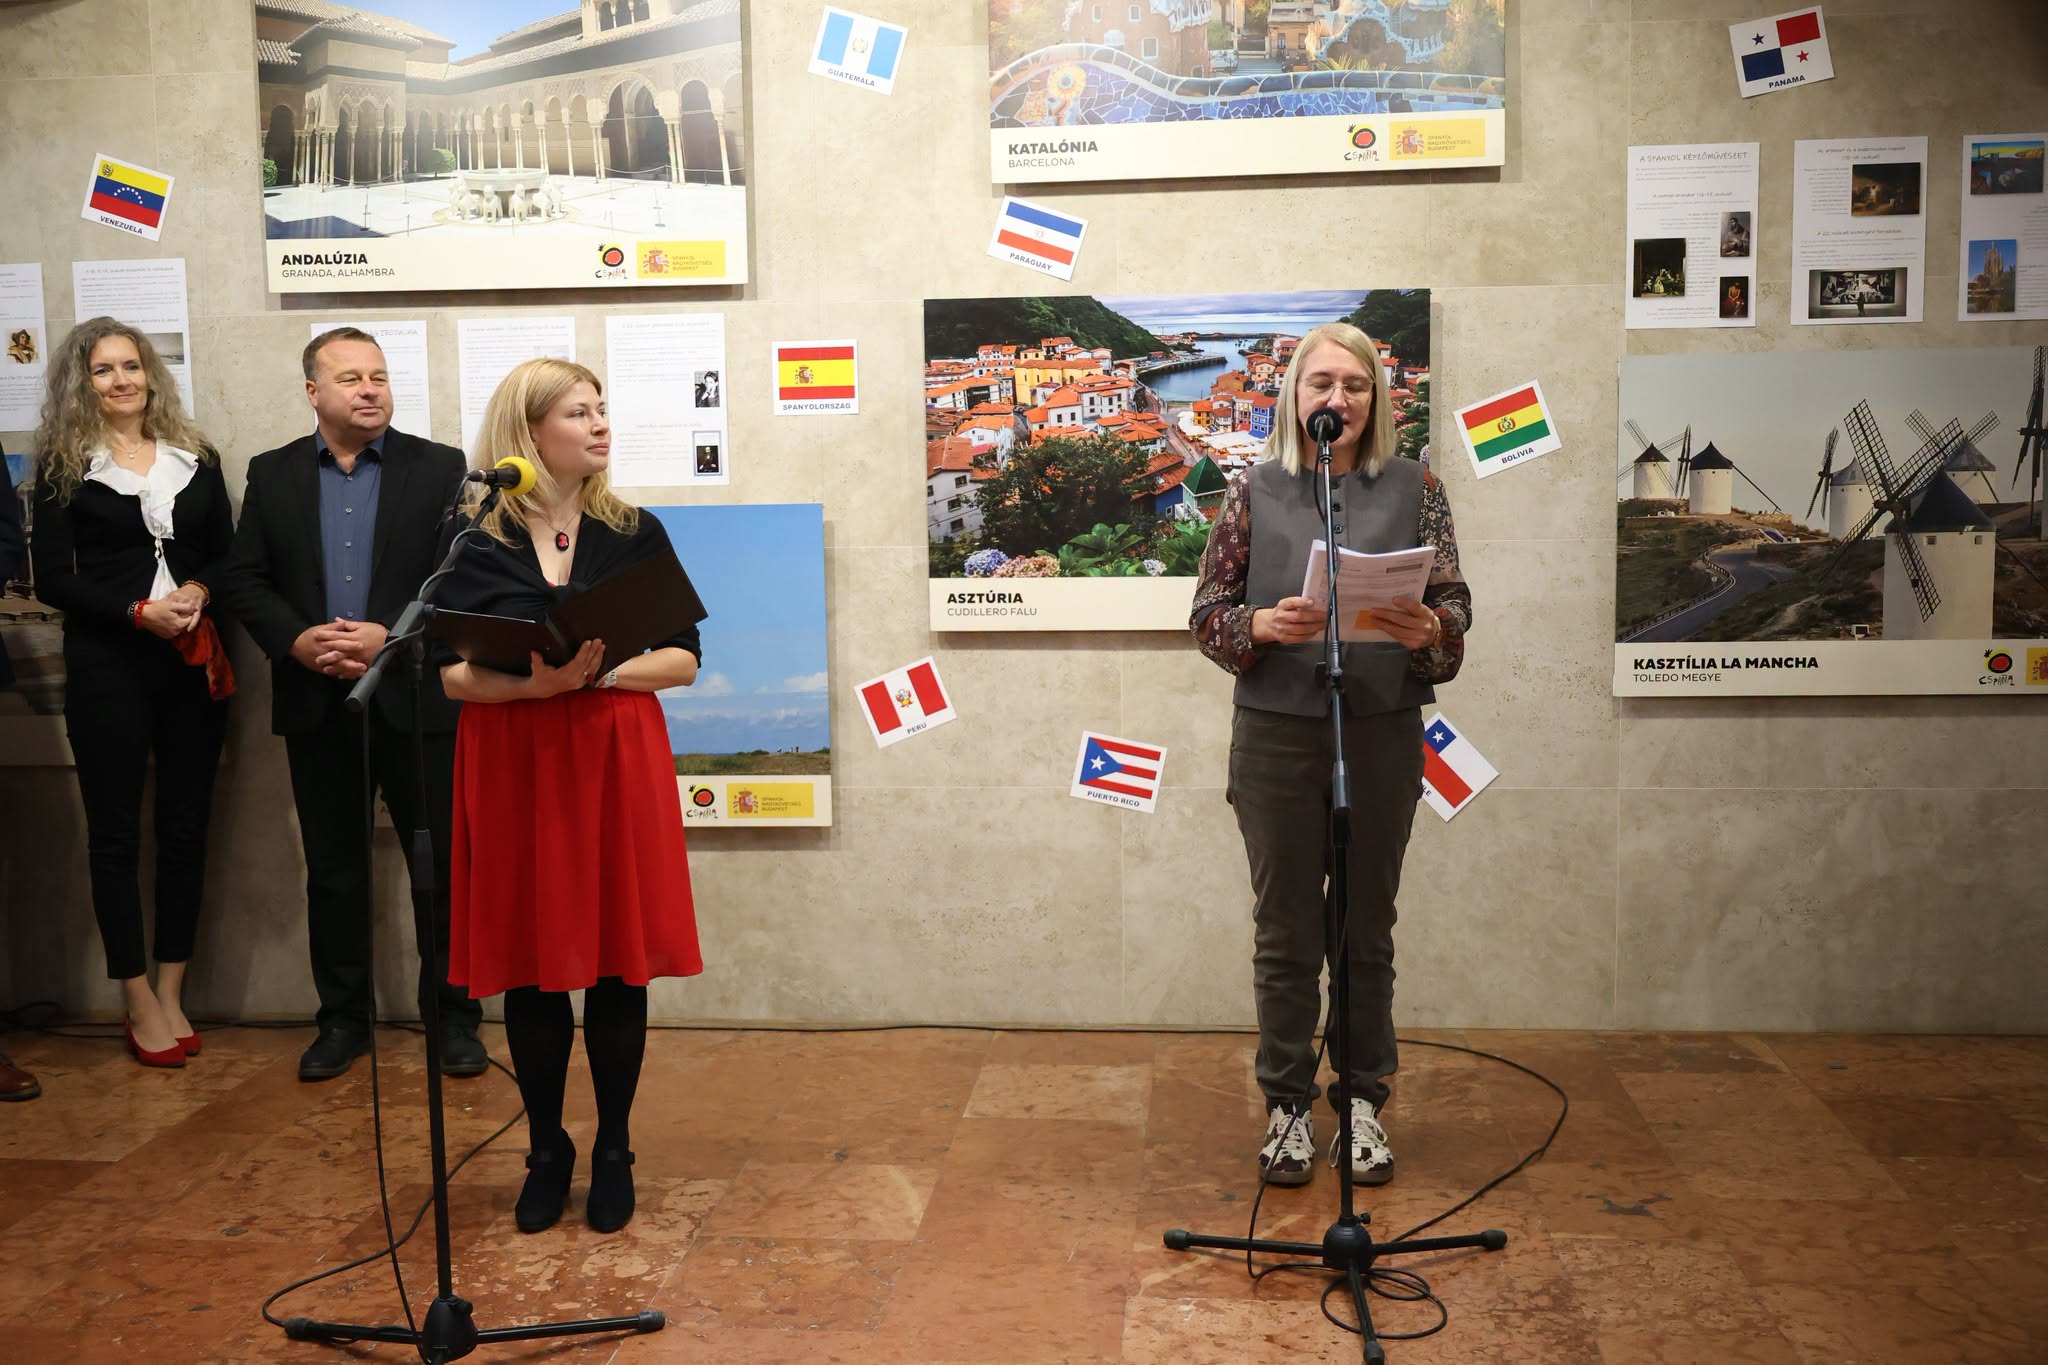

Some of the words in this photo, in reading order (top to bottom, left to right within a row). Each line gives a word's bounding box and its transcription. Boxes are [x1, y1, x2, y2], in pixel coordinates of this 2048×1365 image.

[827, 68, 875, 86] GUATEMALA
[1768, 75, 1805, 88] PANAMA
[1008, 139, 1098, 155] KATALÓNIA
[1008, 158, 1075, 168] BARCELONA
[100, 215, 143, 235] VENEZUELA
[281, 251, 368, 265] ANDALÚZIA
[1009, 252, 1052, 271] PARAGUAY
[281, 268, 336, 278] GRANADA,
[337, 267, 396, 277] ALHAMBRA
[947, 590, 1023, 604] ASZTÚRIA
[947, 607, 1008, 616] CUDILLERO
[1010, 607, 1038, 616] FALU
[1633, 655, 1717, 669] KASZTÍLIA
[1721, 658, 1741, 669] LA
[1745, 657, 1819, 669] MANCHA
[1633, 673, 1679, 682] TOLEDO
[1682, 673, 1722, 682] MEGYE
[906, 722, 927, 734] PERU
[1087, 791, 1119, 802] PUERTO
[1120, 798, 1140, 807] RICO
